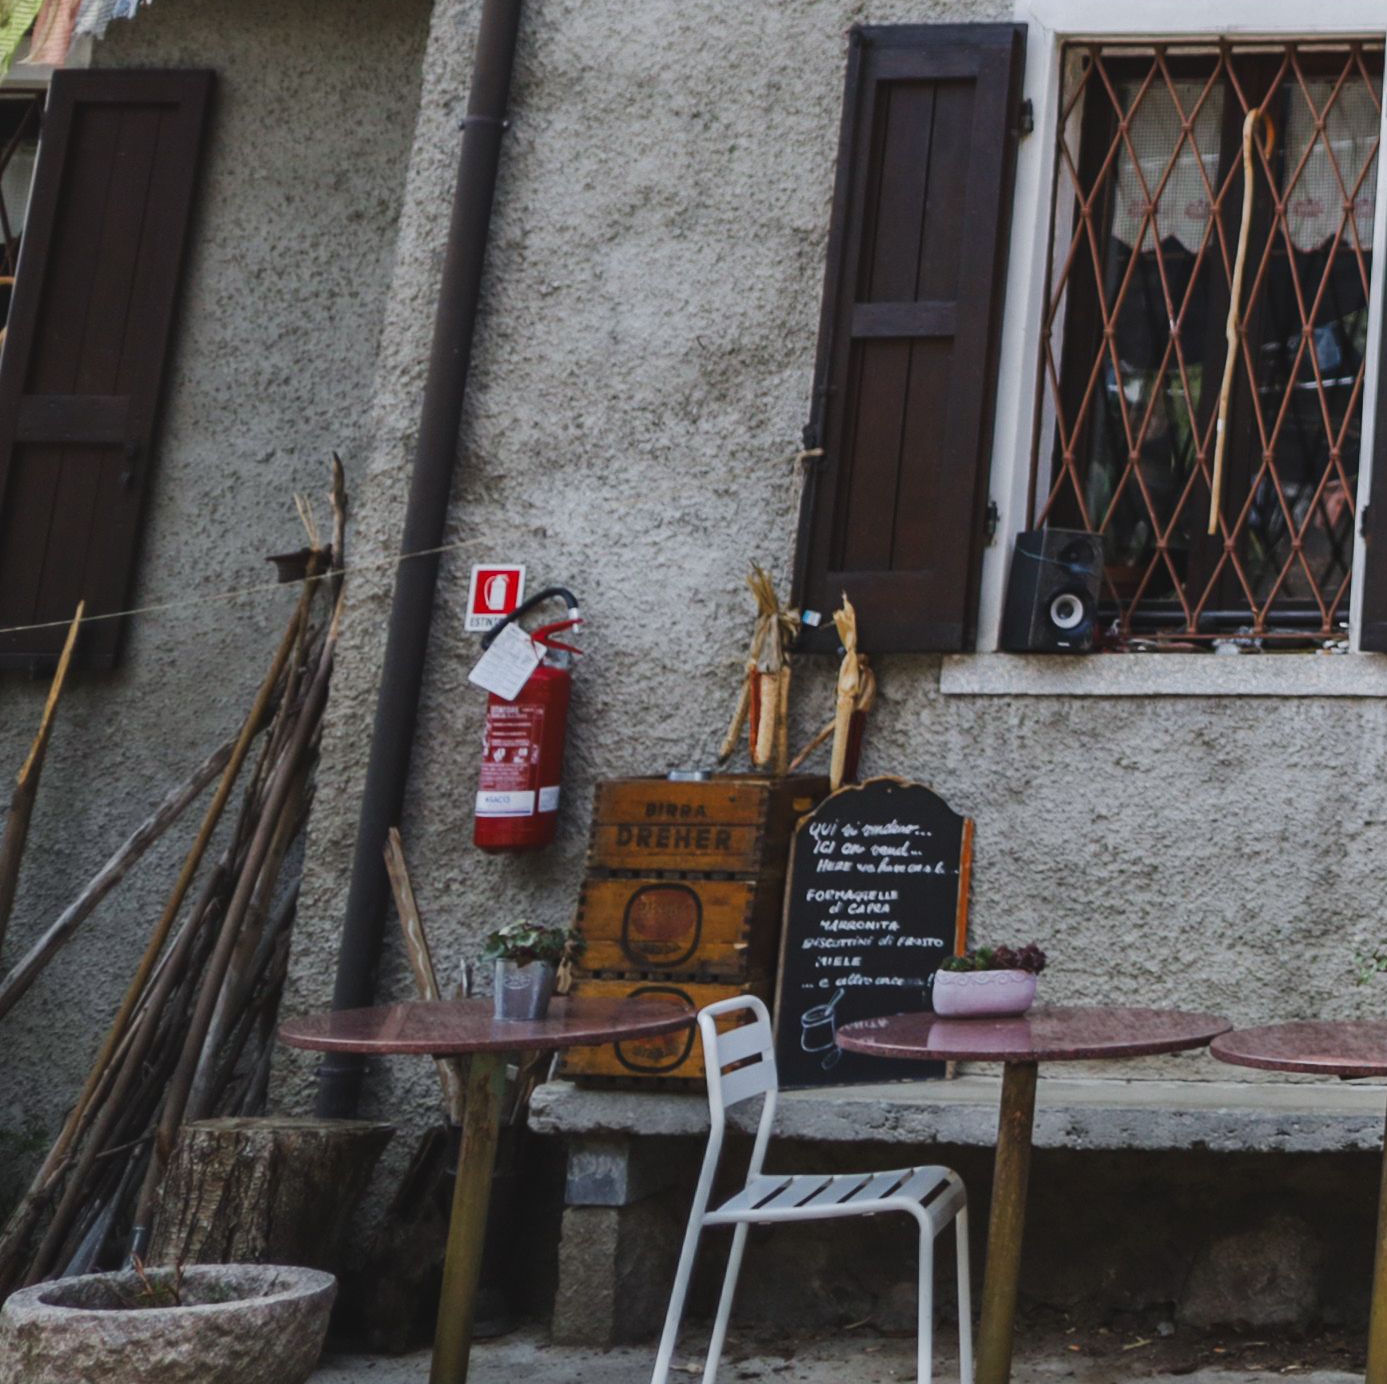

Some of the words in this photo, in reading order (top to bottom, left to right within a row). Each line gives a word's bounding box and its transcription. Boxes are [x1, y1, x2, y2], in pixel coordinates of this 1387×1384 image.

[470, 617, 499, 628] ESTIN
[645, 801, 708, 817] BIRRA
[615, 824, 732, 851] DREHER
[848, 902, 891, 915] CAPRA
[820, 919, 900, 931] MARRONITA
[815, 956, 863, 967] MIELE
